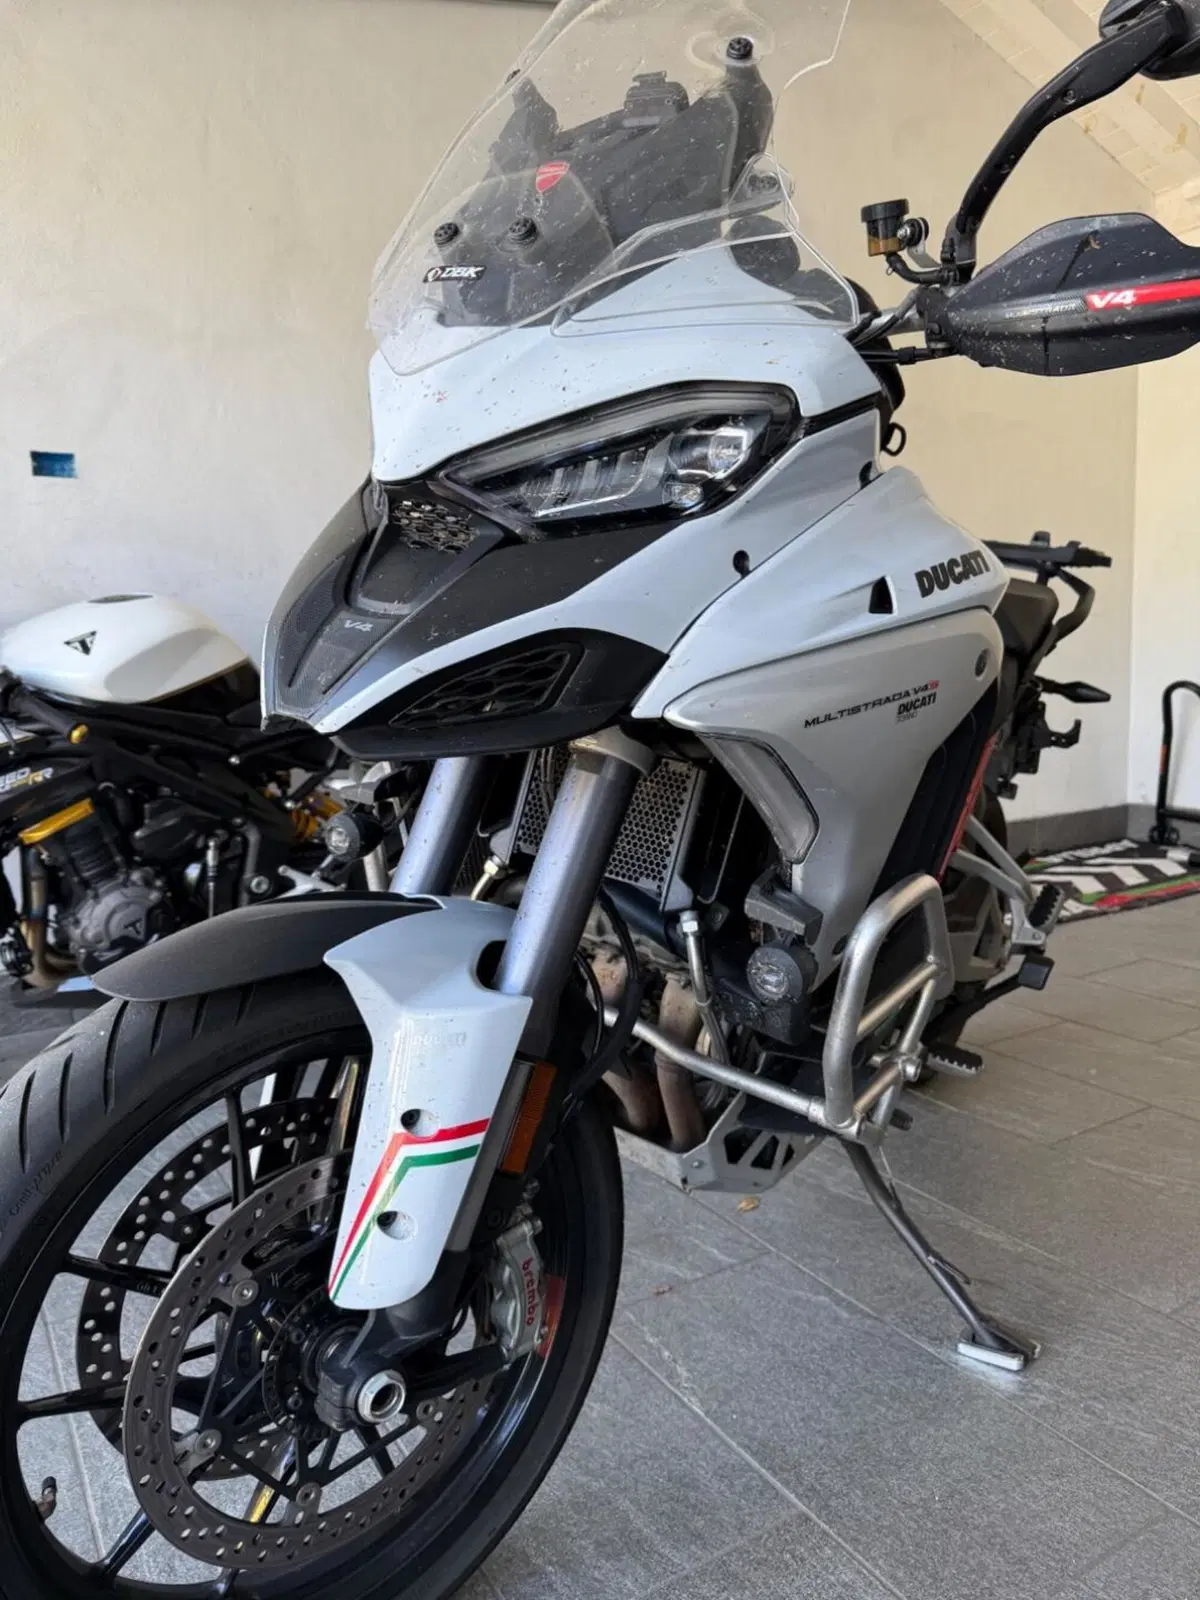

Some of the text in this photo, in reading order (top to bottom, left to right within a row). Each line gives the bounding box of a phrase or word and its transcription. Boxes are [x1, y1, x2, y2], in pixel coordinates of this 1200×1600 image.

[441, 266, 485, 278] DBK
[1087, 290, 1136, 308] V4
[914, 550, 990, 598] DUCATI
[344, 619, 373, 631] V4
[804, 680, 939, 728] MULTISTRADA V4S
[897, 692, 937, 715] DUCATI
[522, 1257, 536, 1327] brembo
